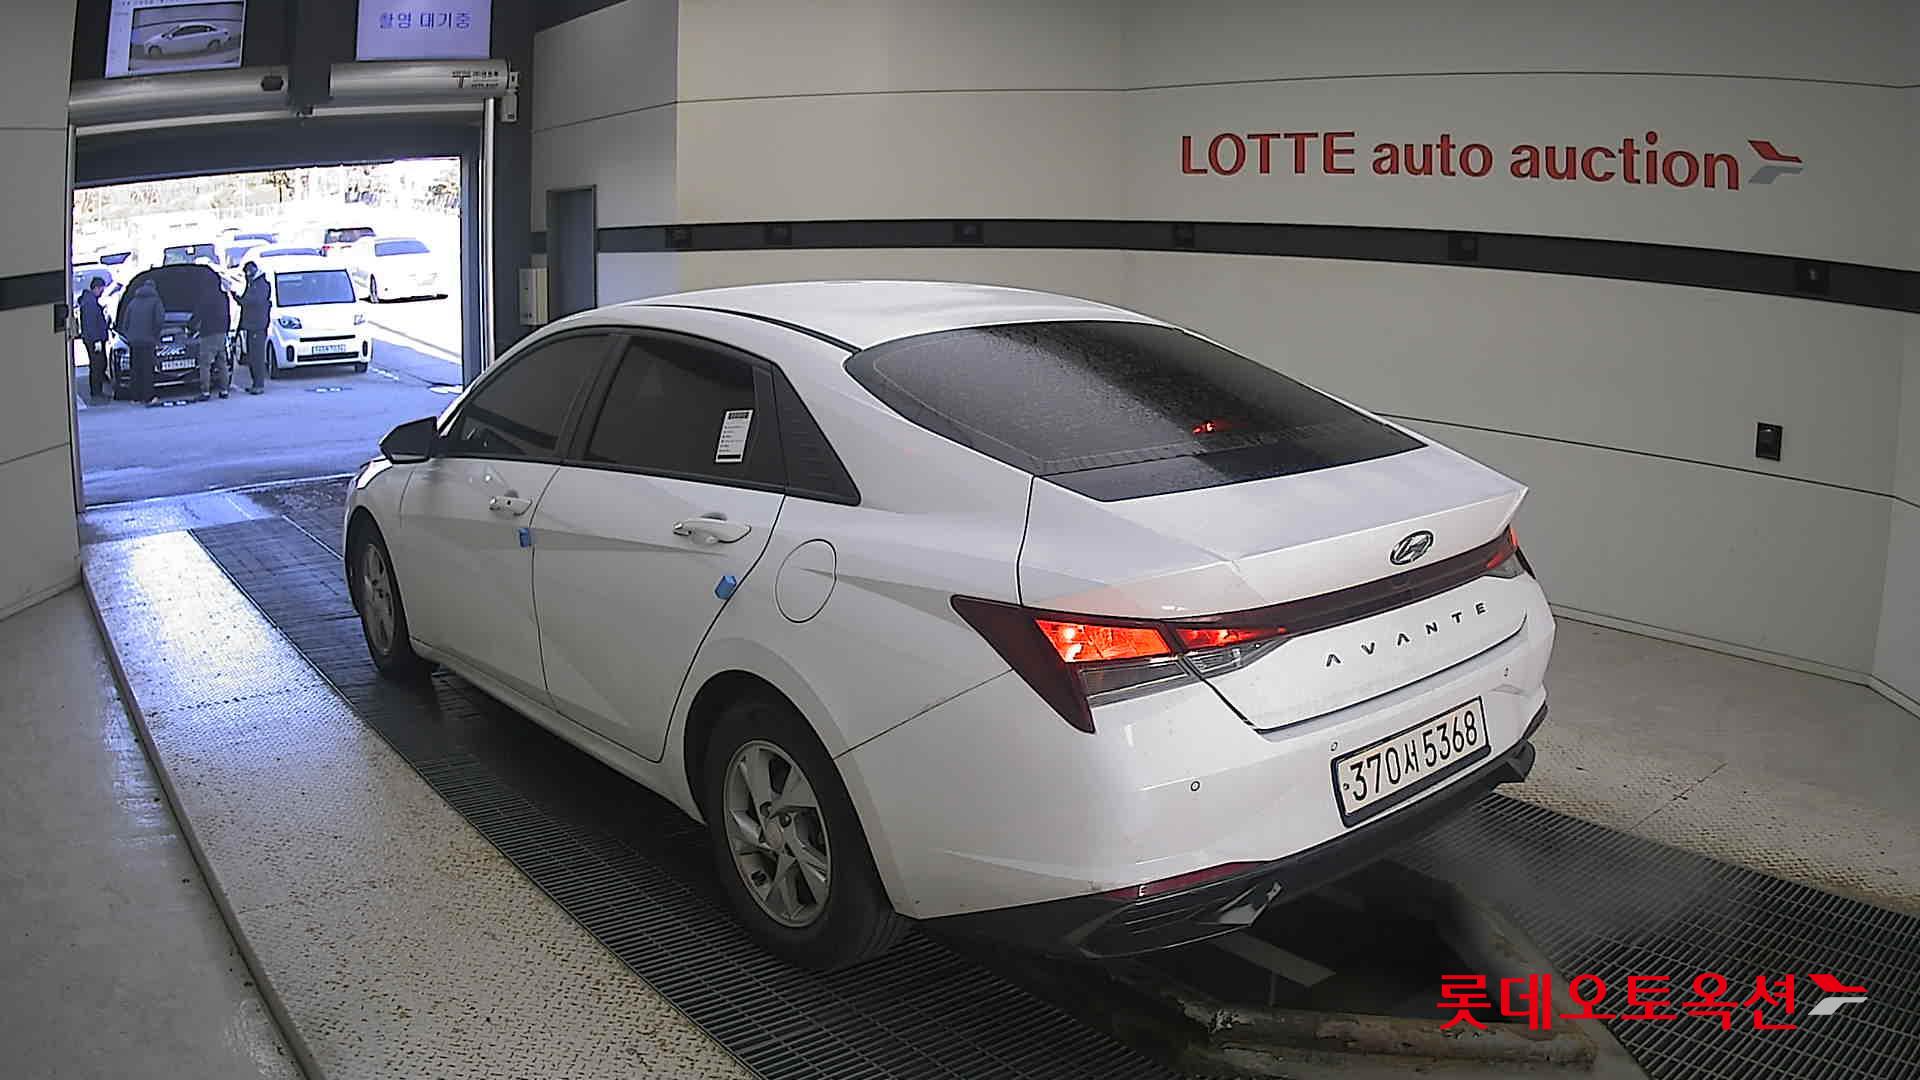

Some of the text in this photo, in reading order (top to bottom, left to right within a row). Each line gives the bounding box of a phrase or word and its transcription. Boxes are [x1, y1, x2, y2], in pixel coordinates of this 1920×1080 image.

[379, 12, 471, 30] 촬영 대기중
[1181, 131, 1740, 190] LOTTE auto auction
[1325, 602, 1487, 667] AVANTE
[1349, 710, 1478, 801] 370서5368
